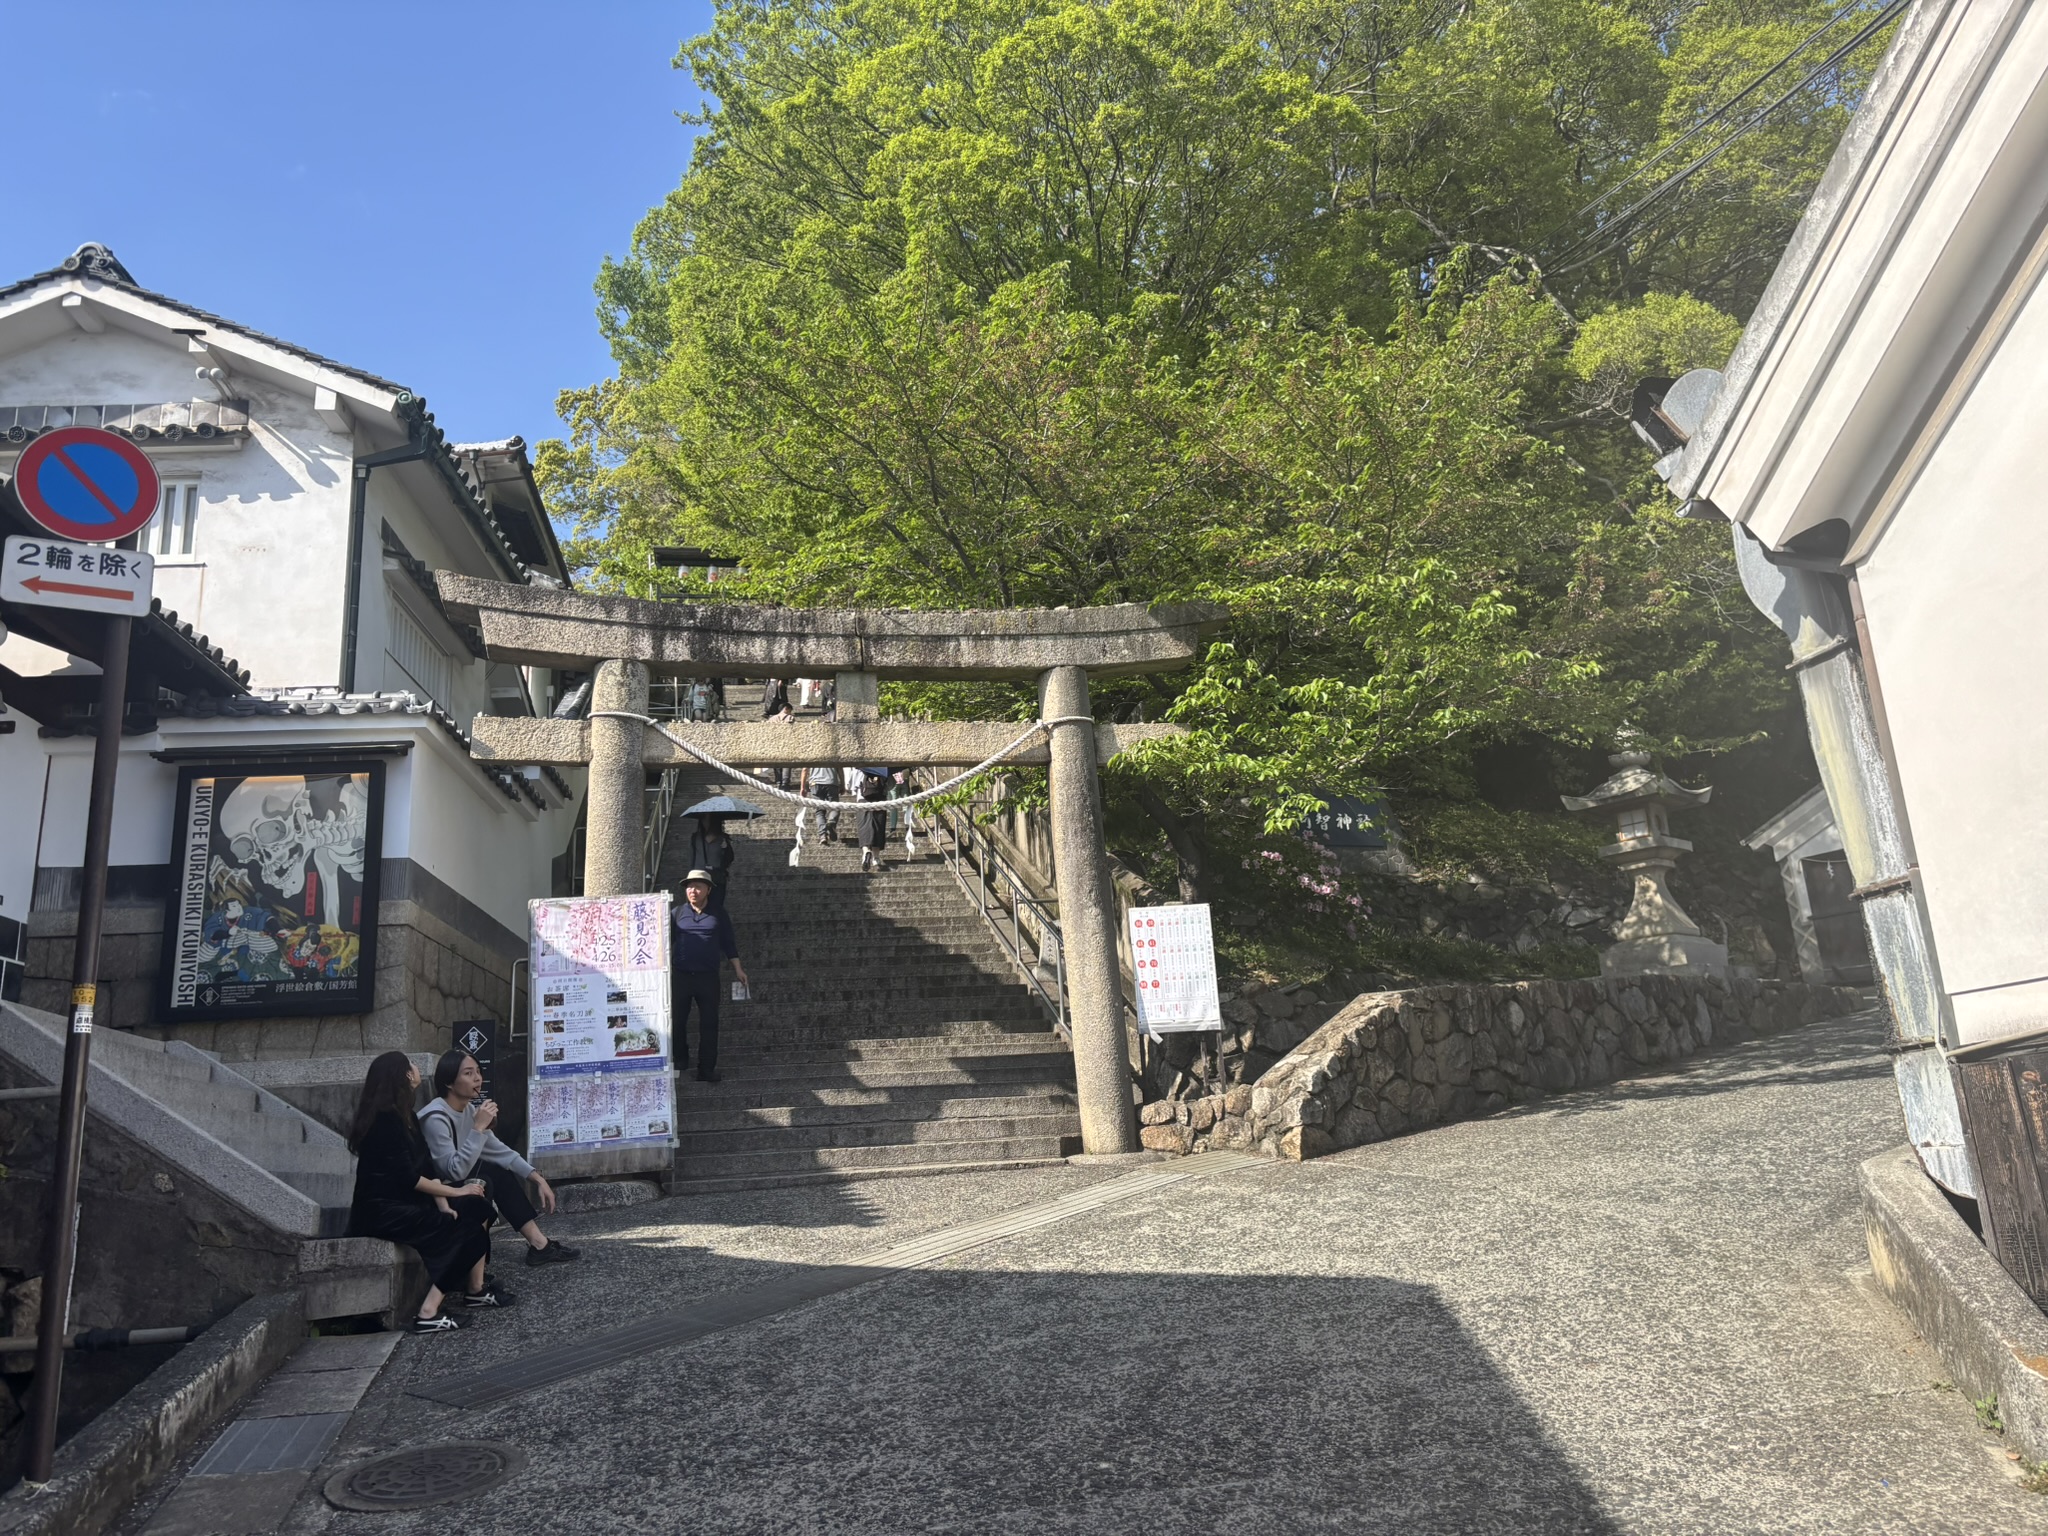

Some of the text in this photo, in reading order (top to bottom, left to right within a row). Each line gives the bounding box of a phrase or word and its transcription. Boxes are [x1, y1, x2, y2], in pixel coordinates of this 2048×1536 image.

[17, 543, 141, 578] 2輪を除く
[193, 785, 212, 839] UKIYO-E
[632, 901, 652, 965] 藤見の会
